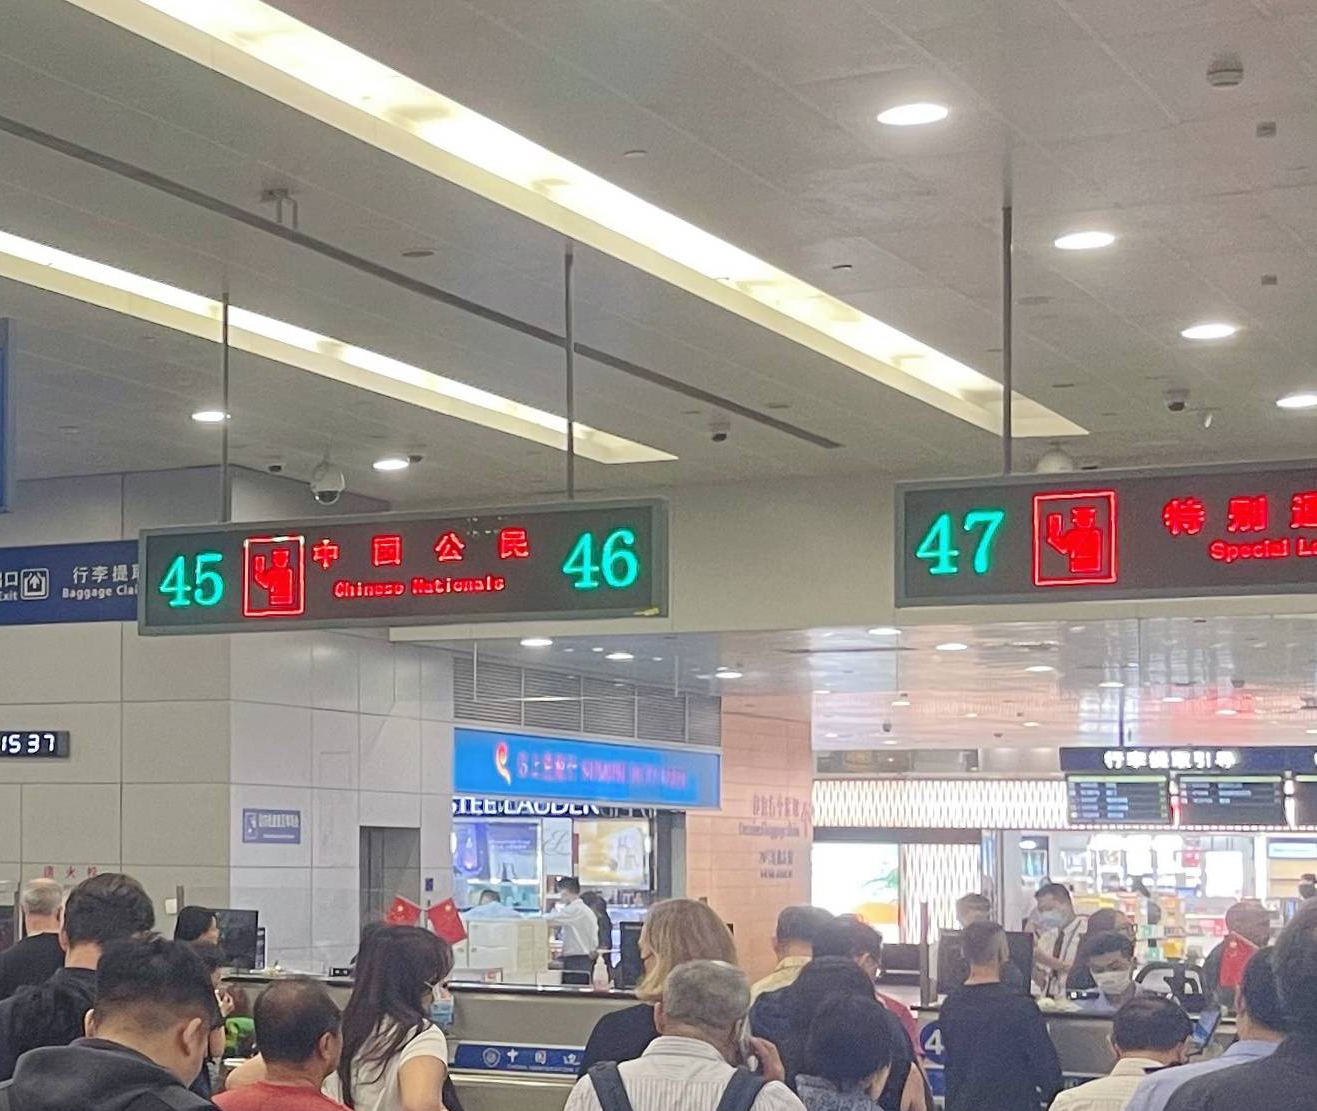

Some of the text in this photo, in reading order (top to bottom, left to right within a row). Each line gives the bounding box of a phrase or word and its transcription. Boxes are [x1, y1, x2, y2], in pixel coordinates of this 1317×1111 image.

[312, 527, 529, 570] 中国公民
[561, 527, 638, 590] 46
[915, 509, 1005, 575] 47
[1208, 539, 1290, 564] Special
[62, 584, 139, 600] Baggage Clai
[158, 552, 224, 607] 45
[334, 576, 506, 599] Chinese Nationals
[924, 1028, 945, 1055] 4
